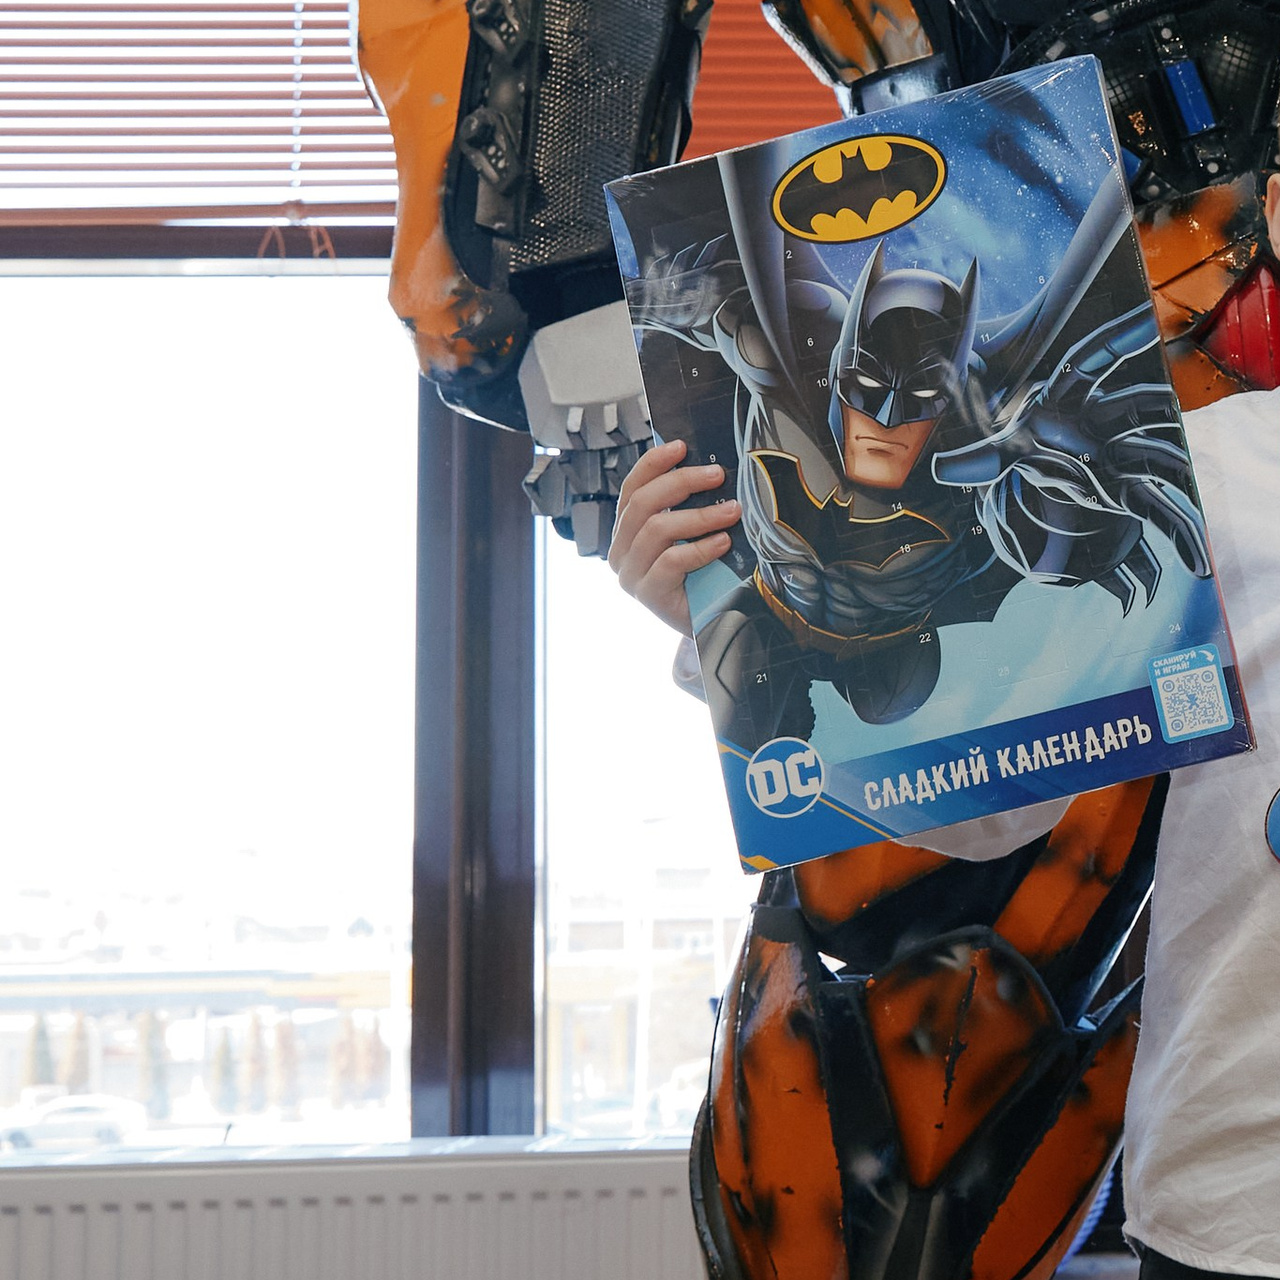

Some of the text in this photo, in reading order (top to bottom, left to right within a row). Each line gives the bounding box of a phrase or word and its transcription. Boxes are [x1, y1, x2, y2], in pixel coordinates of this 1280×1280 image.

[1016, 187, 1023, 197] 4
[786, 250, 793, 259] 2
[912, 260, 918, 269] 7
[670, 280, 676, 289] 1
[1038, 275, 1045, 284] 8
[806, 336, 814, 347] 6
[980, 332, 990, 342] 11
[692, 367, 698, 378] 5
[1060, 363, 1072, 373] 12
[816, 377, 828, 388] 10
[709, 454, 716, 464] 9
[1078, 453, 1090, 464] 16
[960, 484, 972, 494] 15
[1086, 495, 1098, 506] 20
[891, 502, 902, 512] 14
[970, 525, 982, 536] 19
[1168, 624, 1182, 634] 24
[919, 632, 932, 644] 22
[1152, 650, 1197, 668] СКАНИРУЙ
[1154, 661, 1190, 676] И ИГРАЙ!
[756, 673, 768, 684] 21
[864, 715, 1152, 810] СЛАДКИЙ КАЛЕНДАРЬ
[747, 749, 822, 809] DC
